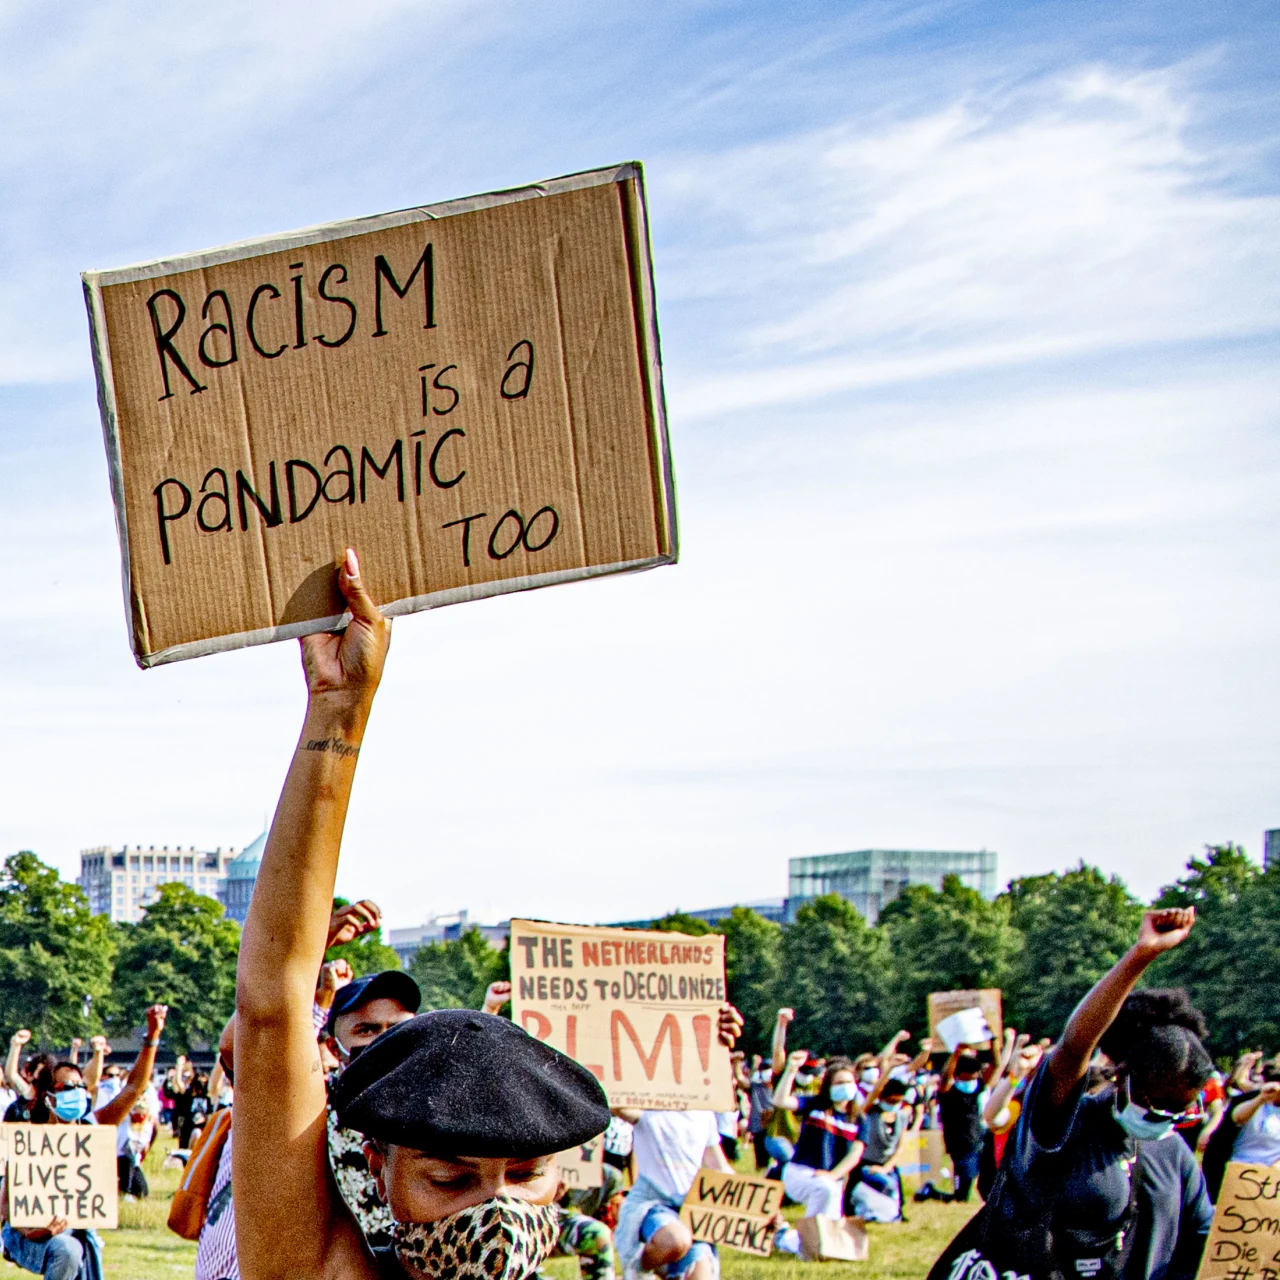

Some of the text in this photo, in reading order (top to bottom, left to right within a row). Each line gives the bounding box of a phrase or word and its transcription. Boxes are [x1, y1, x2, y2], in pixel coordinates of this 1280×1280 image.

[442, 505, 559, 567] TOO
[517, 936, 714, 968] THE NETHERLANDS
[519, 975, 588, 1001] NEEDS
[14, 1129, 92, 1158] BLACK
[13, 1162, 92, 1195] LIVES
[14, 1194, 107, 1219] MATTER
[699, 1176, 777, 1215] WHITE
[689, 1211, 770, 1253] VIOLENCE
[1210, 1240, 1259, 1262] Die
